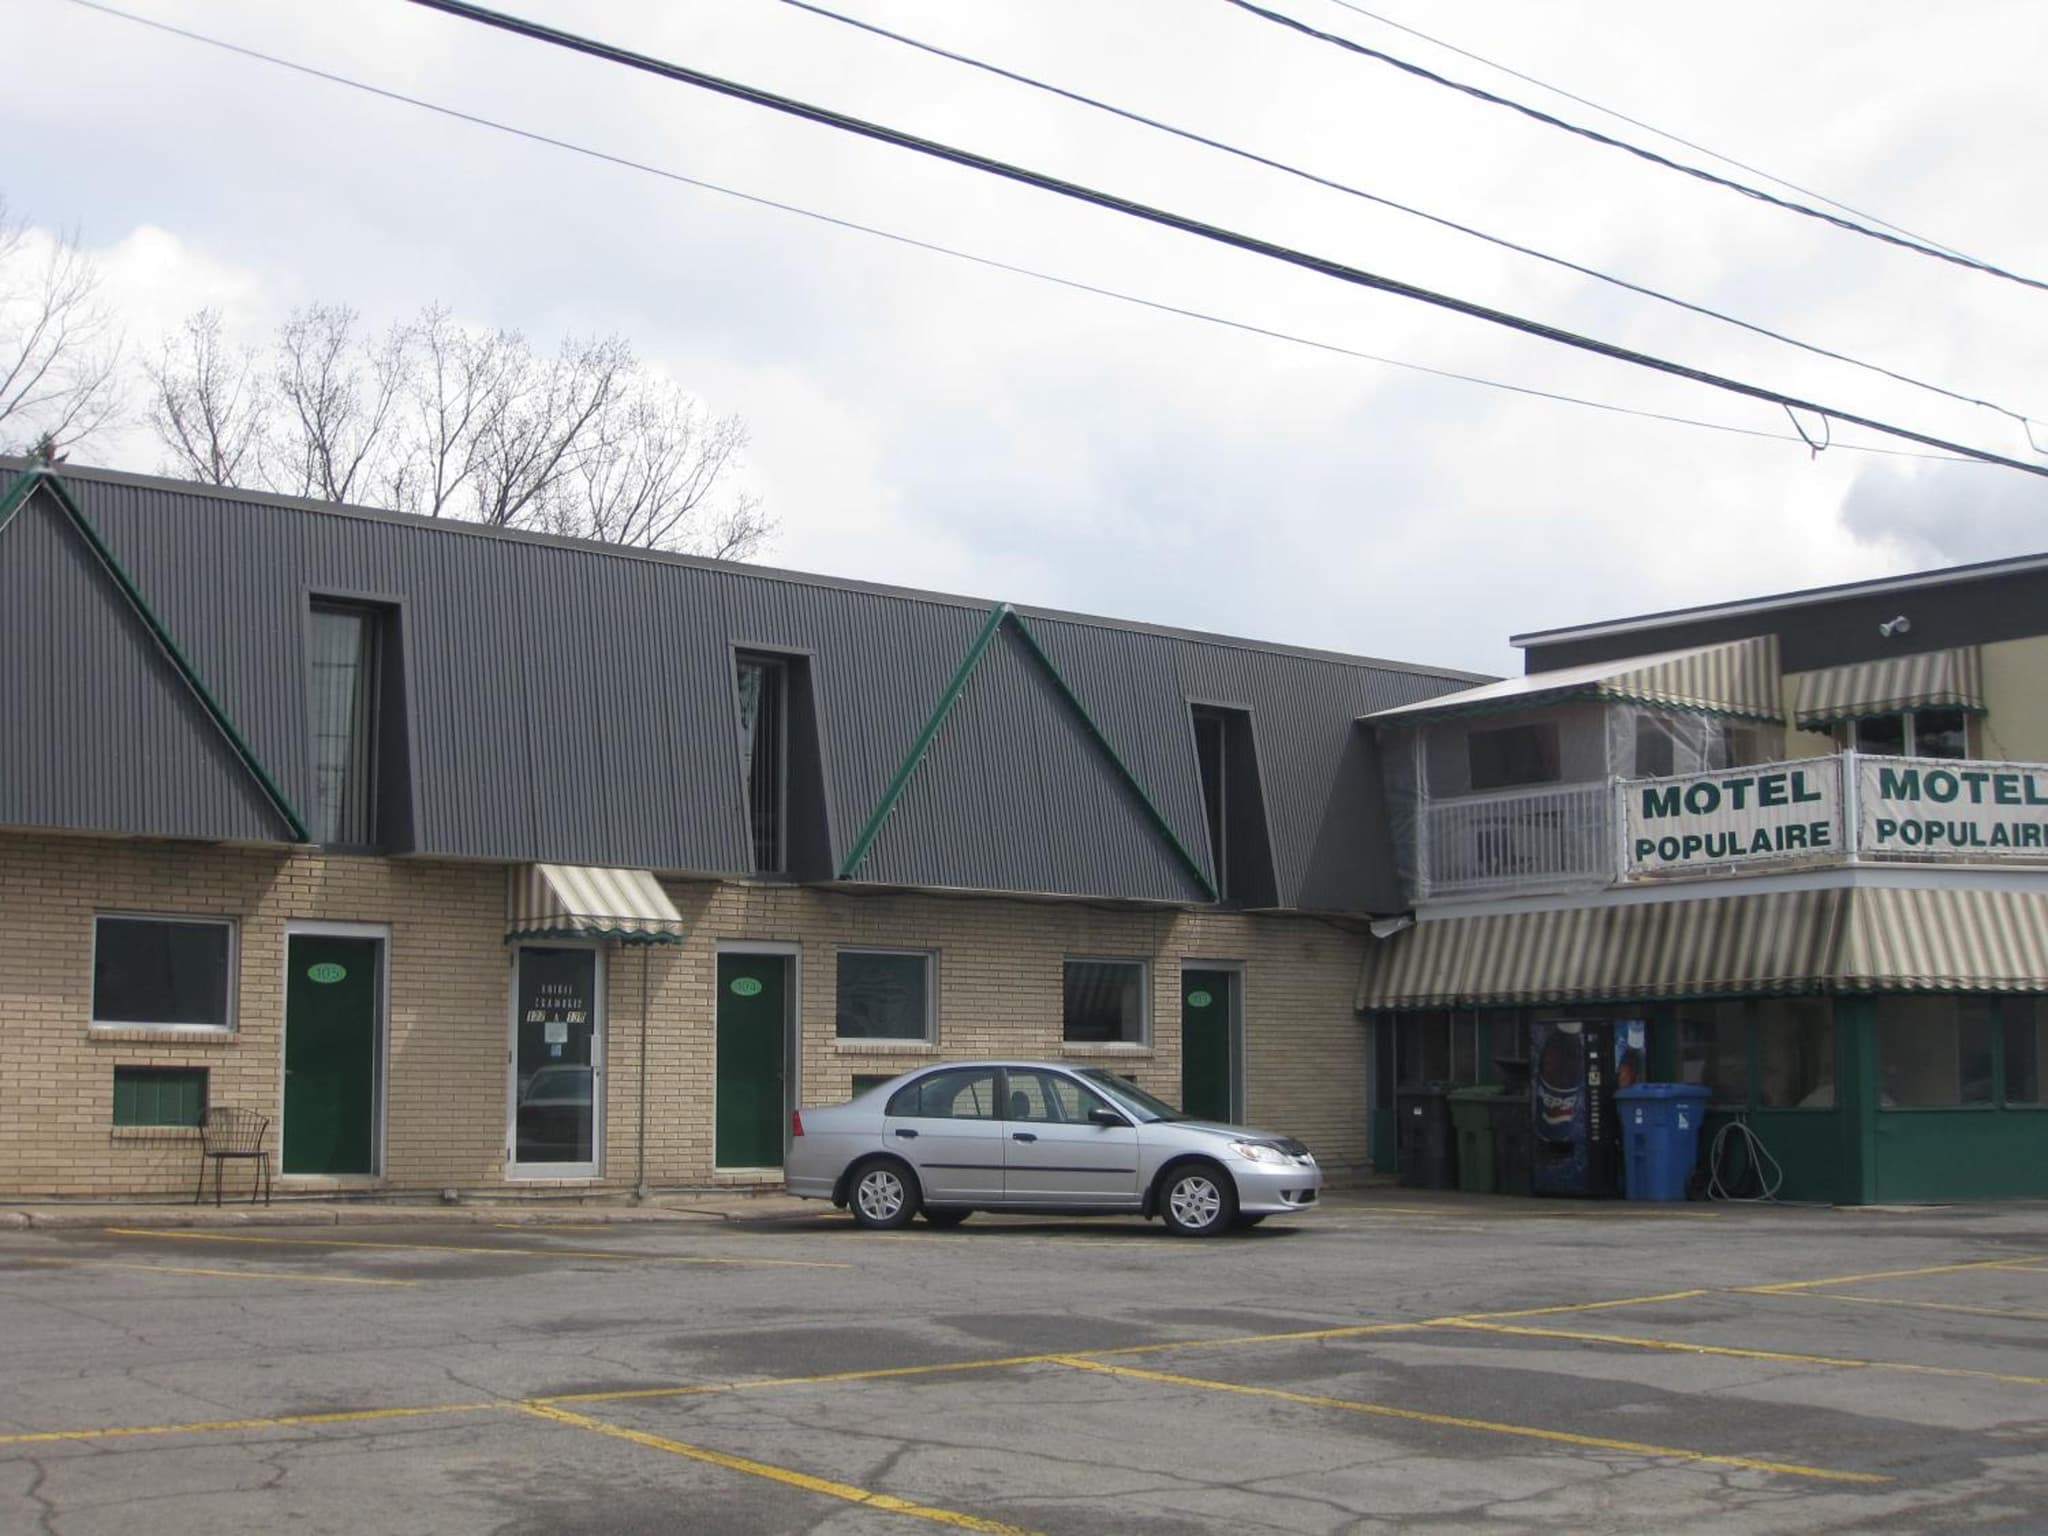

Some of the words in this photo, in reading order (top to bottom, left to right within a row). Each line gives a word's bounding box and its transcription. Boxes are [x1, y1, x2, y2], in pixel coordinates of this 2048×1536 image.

[1642, 770, 1822, 819] MOTEL
[1879, 767, 2048, 805] MOTEL
[1635, 821, 1831, 861] POPULAIRE
[1876, 818, 2048, 848] POPULAIR
